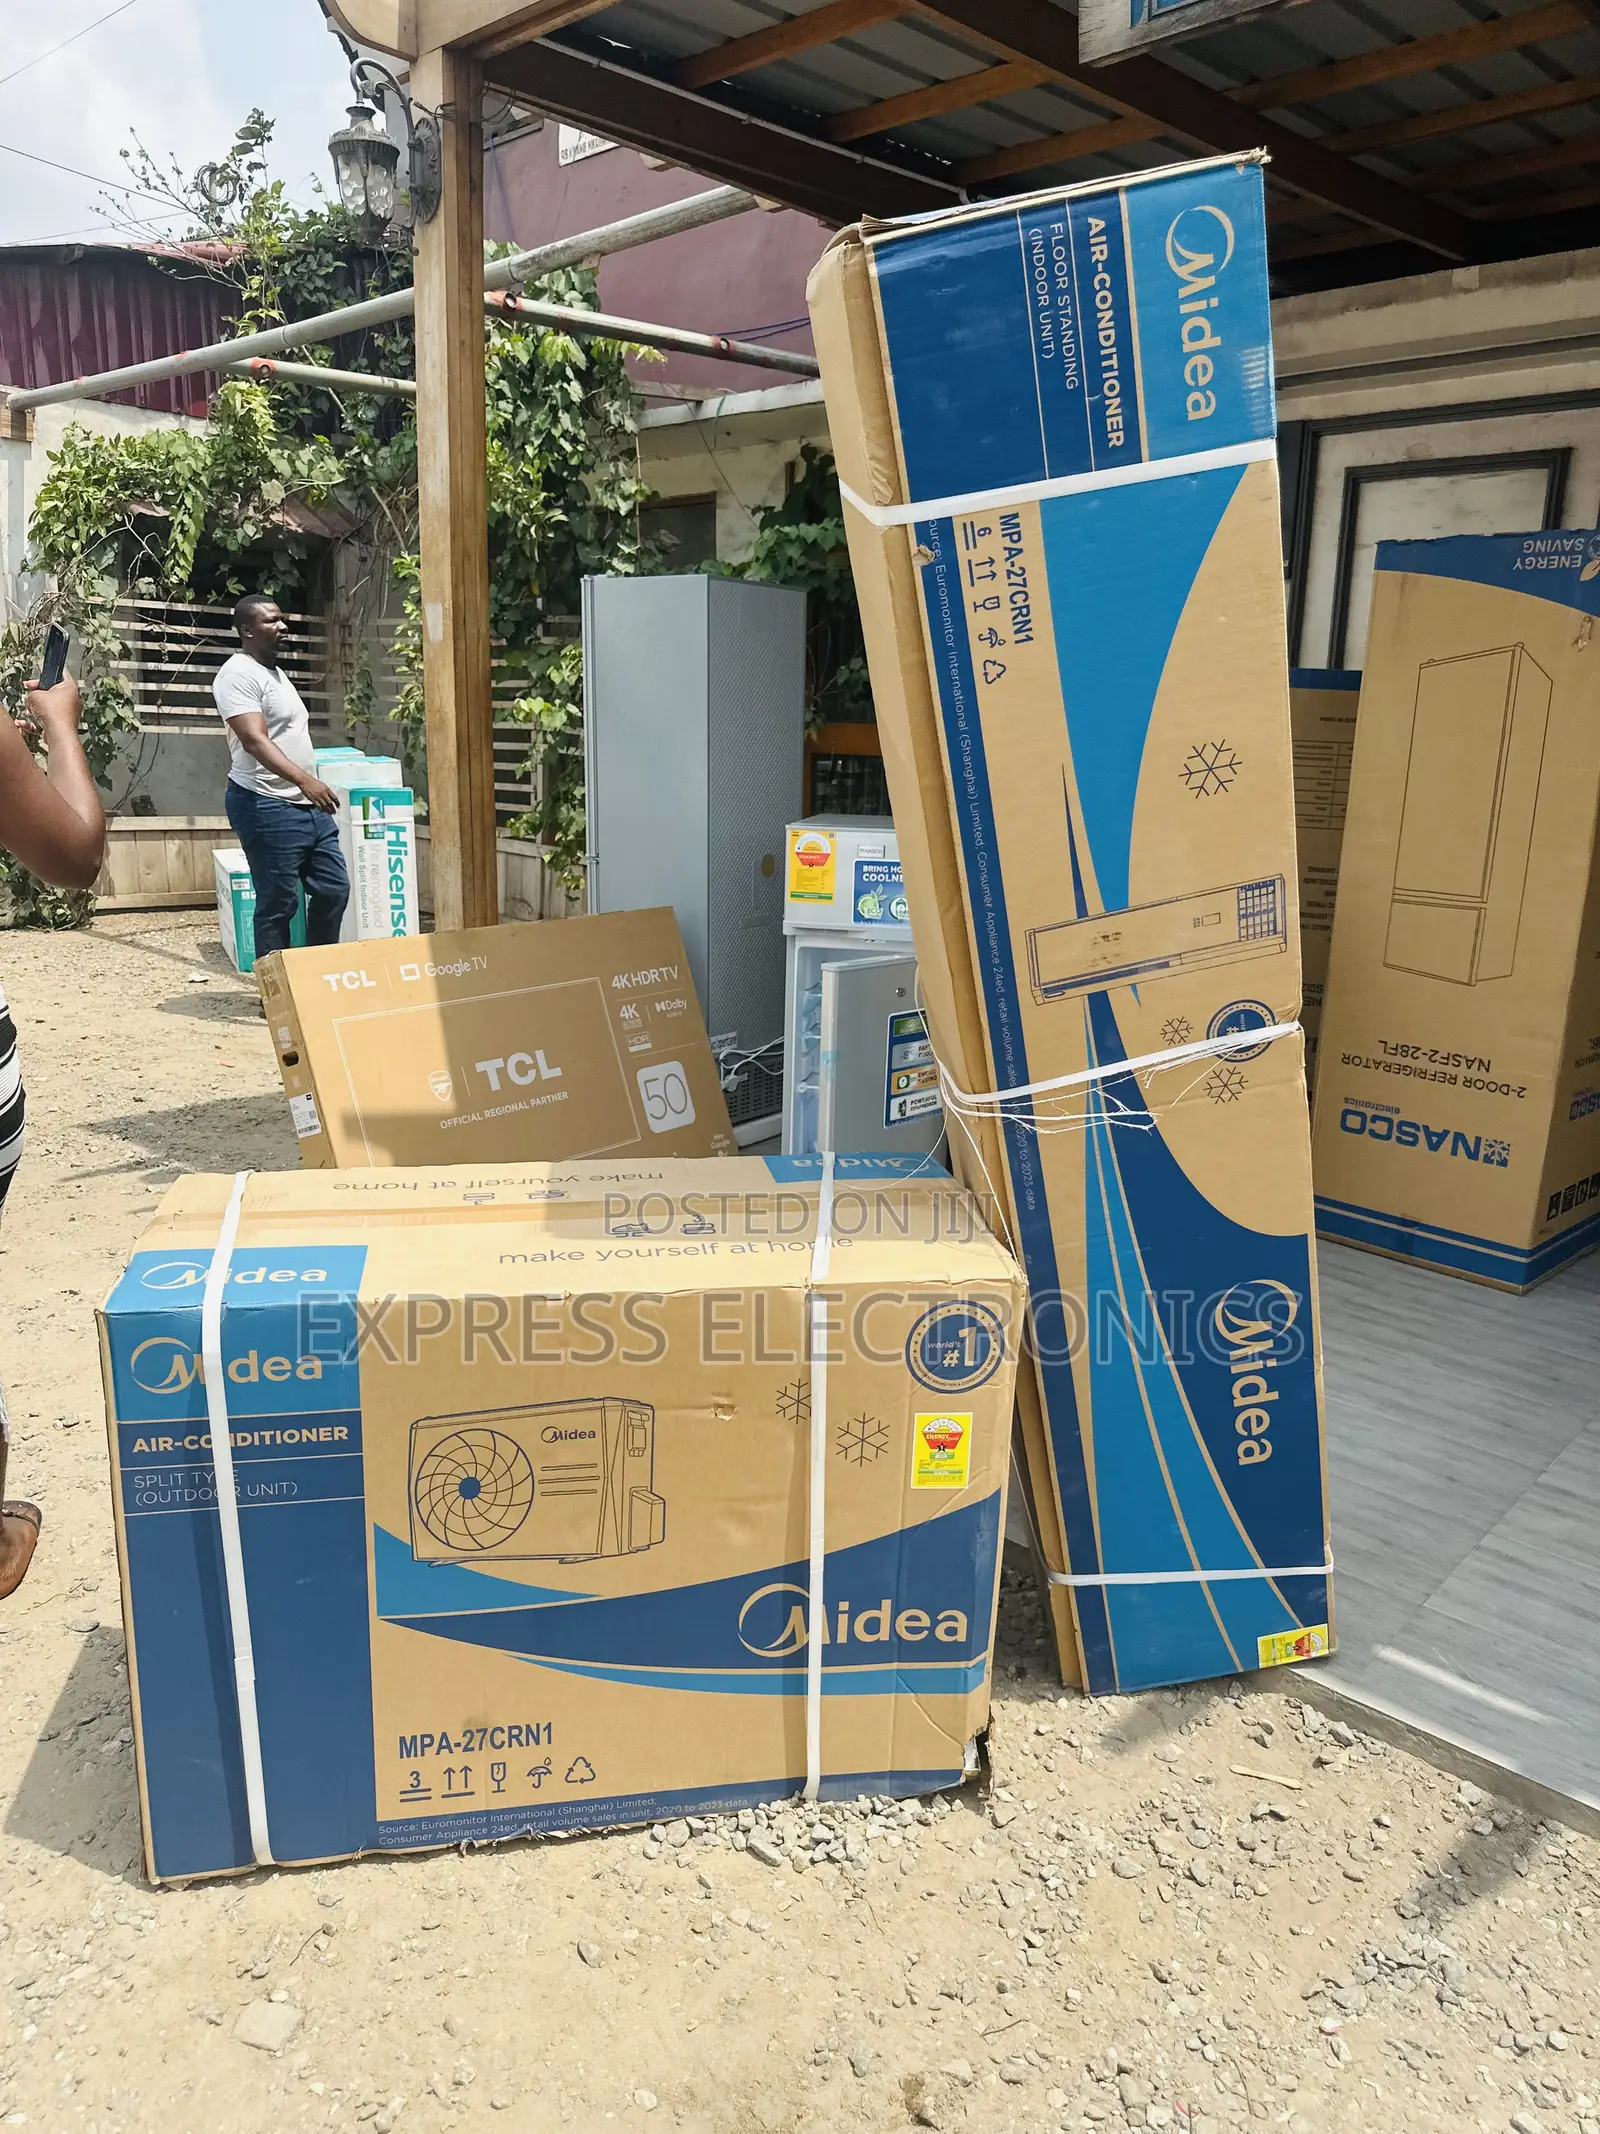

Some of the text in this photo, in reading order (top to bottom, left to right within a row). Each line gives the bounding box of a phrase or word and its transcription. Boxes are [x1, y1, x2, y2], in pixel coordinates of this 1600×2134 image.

[1027, 227, 1056, 360] (INDOOR UNIT)
[1049, 222, 1079, 390] FLOOR STANDING
[1165, 205, 1235, 422] Midea
[1086, 216, 1126, 449] AIR-CONDITIONER
[928, 519, 944, 562] ource:
[976, 525, 992, 538] 6
[1523, 537, 1585, 554] SAVING
[999, 511, 1035, 645] MPA-27CRN1
[1513, 555, 1583, 571] ENERGY
[934, 564, 955, 649] Euromonitor
[948, 651, 967, 732] International
[958, 733, 976, 801] (Shanghai)
[358, 845, 369, 929] Wall Split Indoor Unit
[862, 864, 903, 874] BRING HO
[977, 851, 992, 909] Consumer
[985, 910, 1000, 965] Appliance
[322, 956, 488, 991] TCL Google TV
[620, 998, 687, 1020] 4K Dolby
[999, 998, 1009, 1022] retail
[1002, 1021, 1014, 1061] volume
[1378, 1040, 1492, 1074] NASF2-28FL
[475, 1049, 564, 1092] TCL
[1007, 1063, 1019, 1087] sales
[1341, 1052, 1528, 1099] 2-DOOR REFRIGERATOR
[440, 1090, 569, 1130] OFFICIAL REGIONAL PARTNER
[644, 1073, 688, 1121] 50
[1343, 1096, 1401, 1116] electronics
[1015, 1123, 1028, 1148] 2020
[1340, 1108, 1483, 1162] NASCO
[1020, 1149, 1029, 1160] to
[333, 1172, 664, 1192] make yourself at home
[1021, 1162, 1034, 1187] 2023
[1026, 1188, 1037, 1211] data
[499, 1250, 585, 1265] make
[595, 1241, 720, 1263] yourself
[731, 1242, 759, 1255] at
[927, 1341, 963, 1350] world's
[131, 1336, 323, 1394] Mdea
[1214, 1279, 1298, 1467] Midea
[540, 1426, 596, 1443] Midea
[134, 1469, 239, 1489] SPLIT TYE
[247, 1481, 298, 1497] UNIT)
[399, 1721, 553, 1760] MPA-27CRN1
[408, 1770, 422, 1789] 3
[378, 1823, 419, 1835] Source:
[421, 1816, 487, 1830] Euromonitor
[490, 1807, 556, 1822] International
[558, 1801, 614, 1817] (Shanghai)
[379, 1832, 433, 1846] Consumer
[436, 1826, 488, 1840] Appliance
[551, 1815, 589, 1827] volume
[592, 1812, 617, 1823] sales
[619, 1810, 629, 1820] in
[656, 1804, 683, 1814] 2020
[684, 1804, 696, 1813] to
[698, 1801, 723, 1811] 2023
[724, 1798, 748, 1808] data
